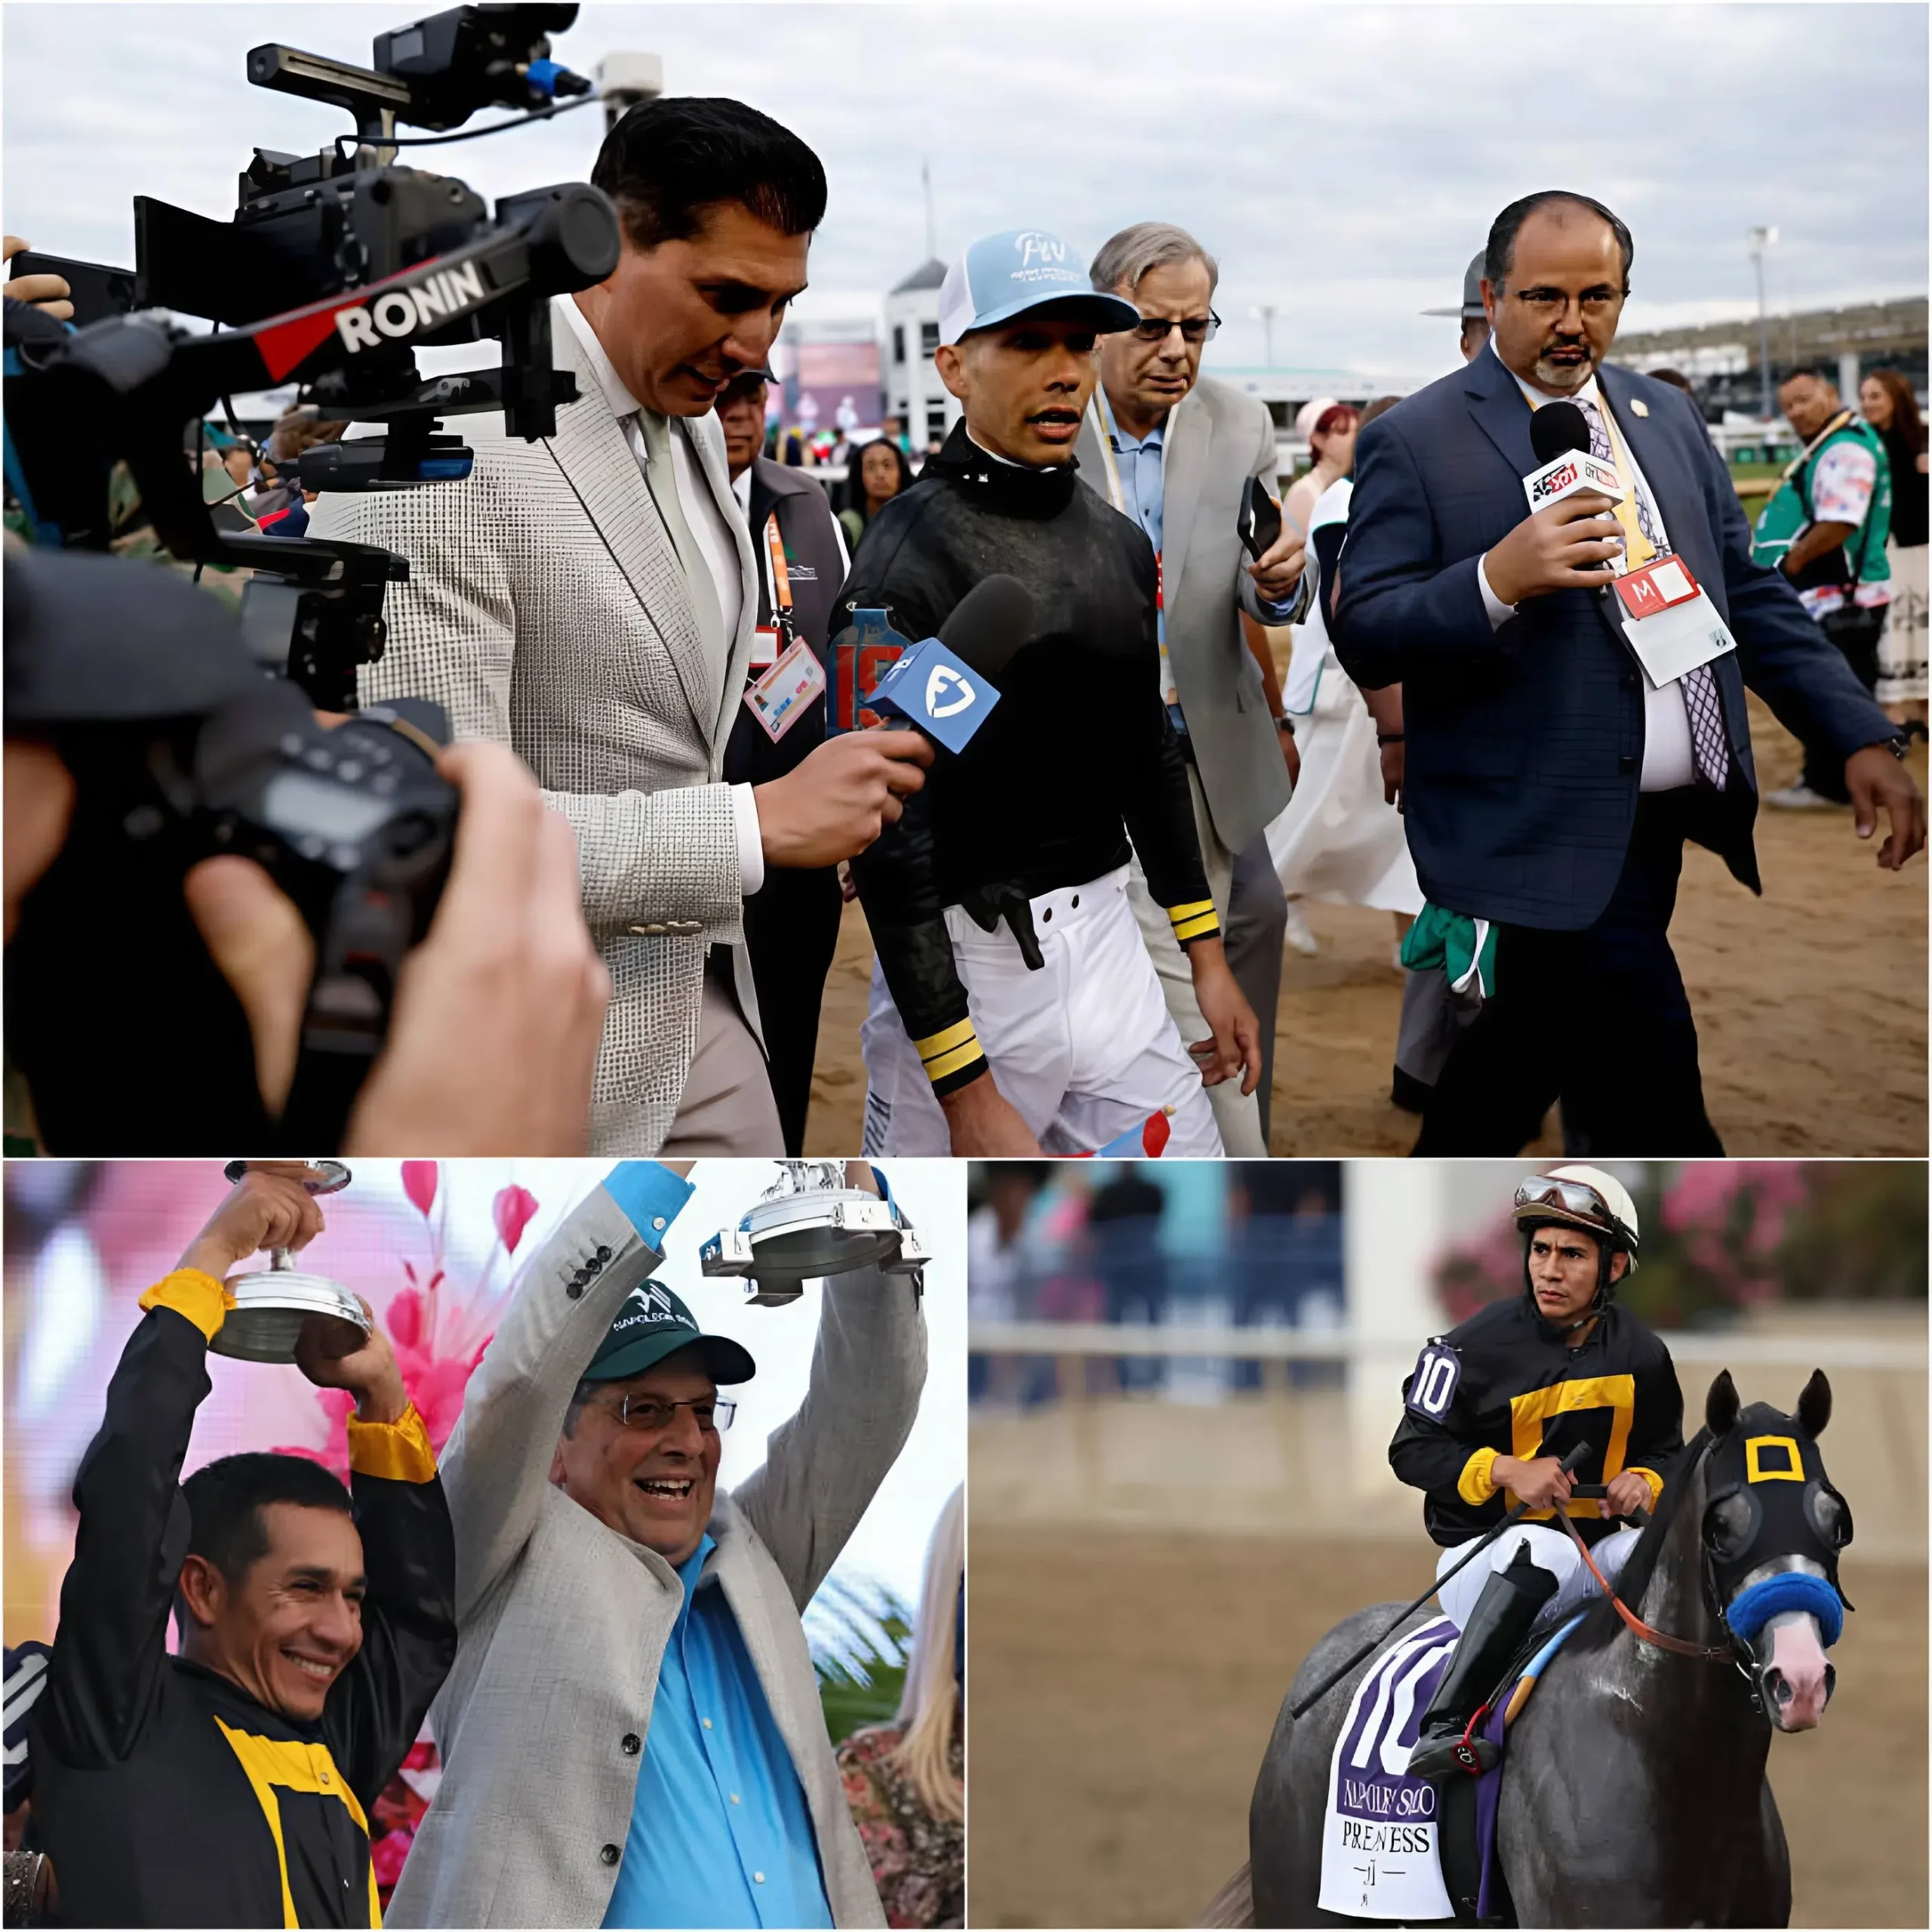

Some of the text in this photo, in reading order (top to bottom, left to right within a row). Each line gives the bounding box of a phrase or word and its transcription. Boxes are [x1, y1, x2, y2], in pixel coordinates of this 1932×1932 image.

[334, 260, 484, 353] RONIN
[1631, 580, 1656, 602] M
[1412, 1352, 1456, 1414] 10
